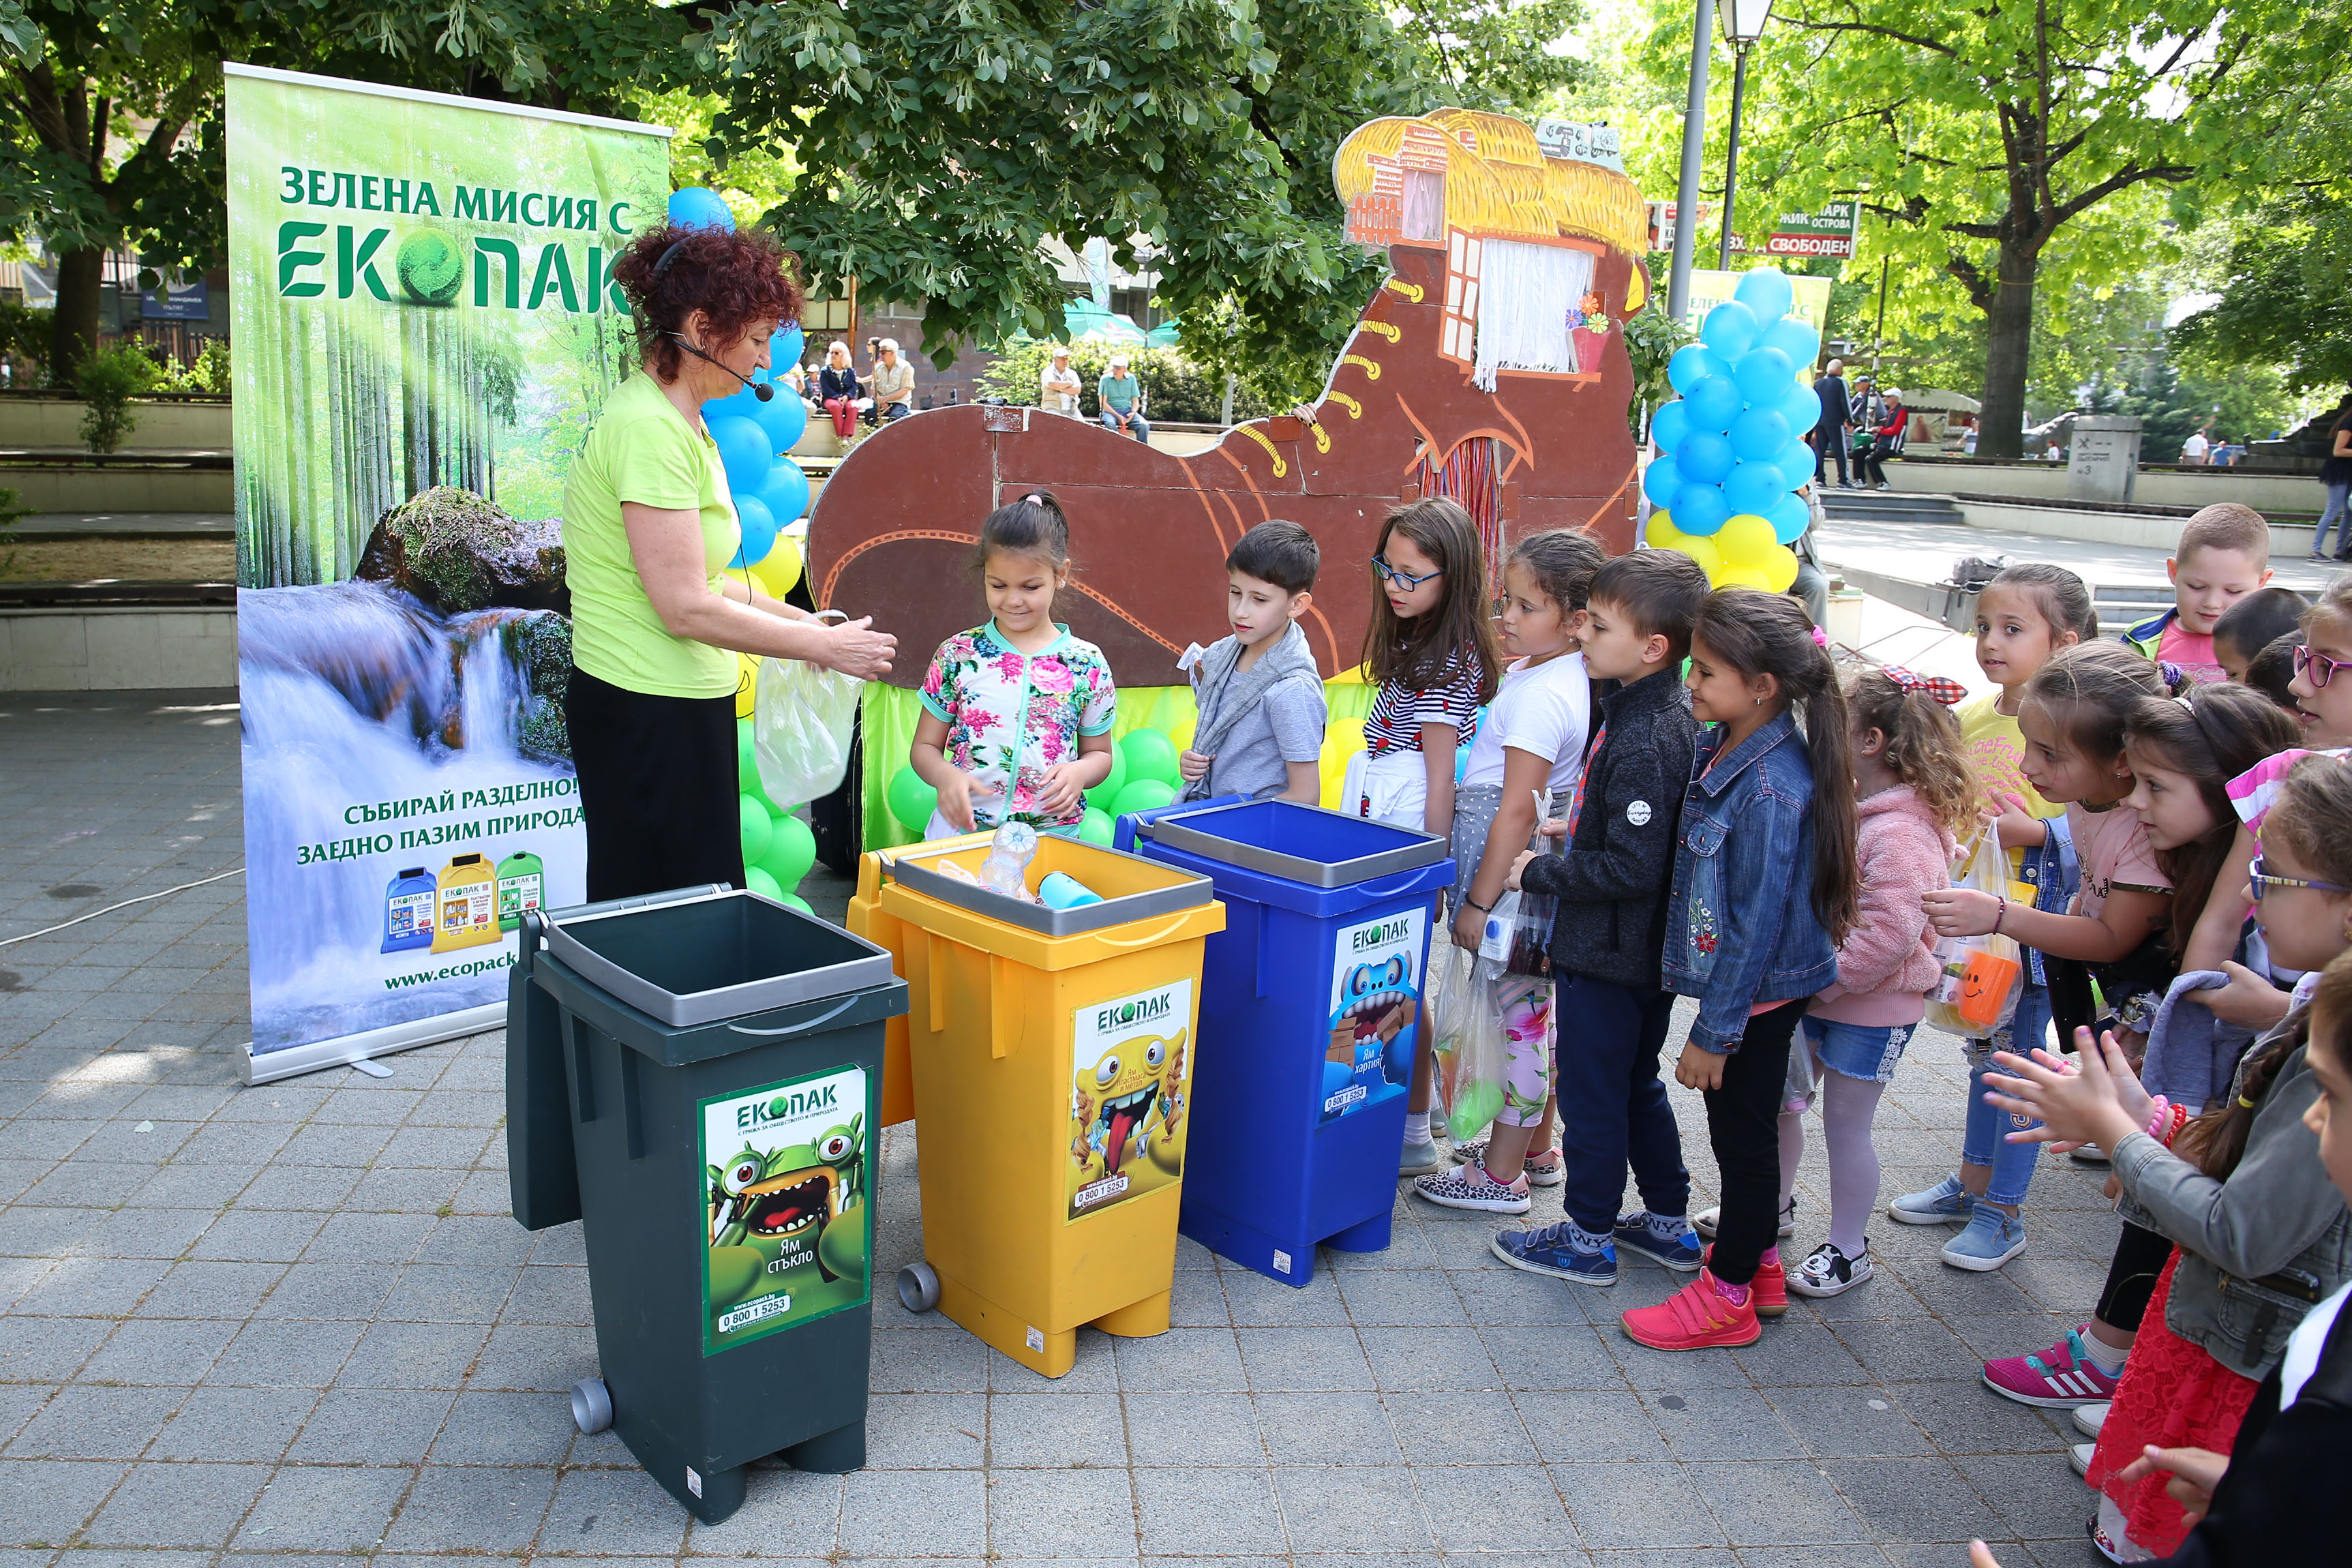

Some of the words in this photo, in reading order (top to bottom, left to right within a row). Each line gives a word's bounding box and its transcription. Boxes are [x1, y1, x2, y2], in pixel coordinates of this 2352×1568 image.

[280, 166, 442, 217] ЗЕЛЕНА
[453, 185, 597, 231] МИСИЯ
[609, 202, 634, 235] С
[1816, 205, 1850, 217] АРК
[1811, 218, 1851, 228] ОСТРОВА
[1770, 238, 1850, 256] СВОБОДЕН
[344, 789, 454, 824] СЪБИРАЙ
[462, 778, 578, 810] РАЗДЕЛНО!
[297, 833, 393, 865] ЗАЕДНО
[400, 821, 480, 849] ПАЗИМ
[487, 806, 585, 835] ПРИРОДА
[385, 950, 517, 990] www.ecopack
[1363, 1049, 1374, 1061] Ям
[1355, 1057, 1380, 1074] хартия
[1333, 1096, 1343, 1105] 800
[1350, 1089, 1363, 1099] 5253
[742, 1127, 761, 1135] ГРИЖА
[769, 1116, 804, 1128] ОБЩЕСТВОТО
[810, 1106, 839, 1118] ПРИРОДАТА
[1079, 1194, 1083, 1202] 0
[1085, 1189, 1098, 1200] 800
[1107, 1179, 1124, 1192] 5253
[781, 1239, 800, 1256] Ям
[768, 1250, 813, 1273] стъкло
[734, 1293, 775, 1311] www.ecopack.bg
[724, 1316, 729, 1326] 0
[733, 1310, 750, 1324] 800
[754, 1308, 758, 1316] 1
[762, 1299, 785, 1314] 5253
